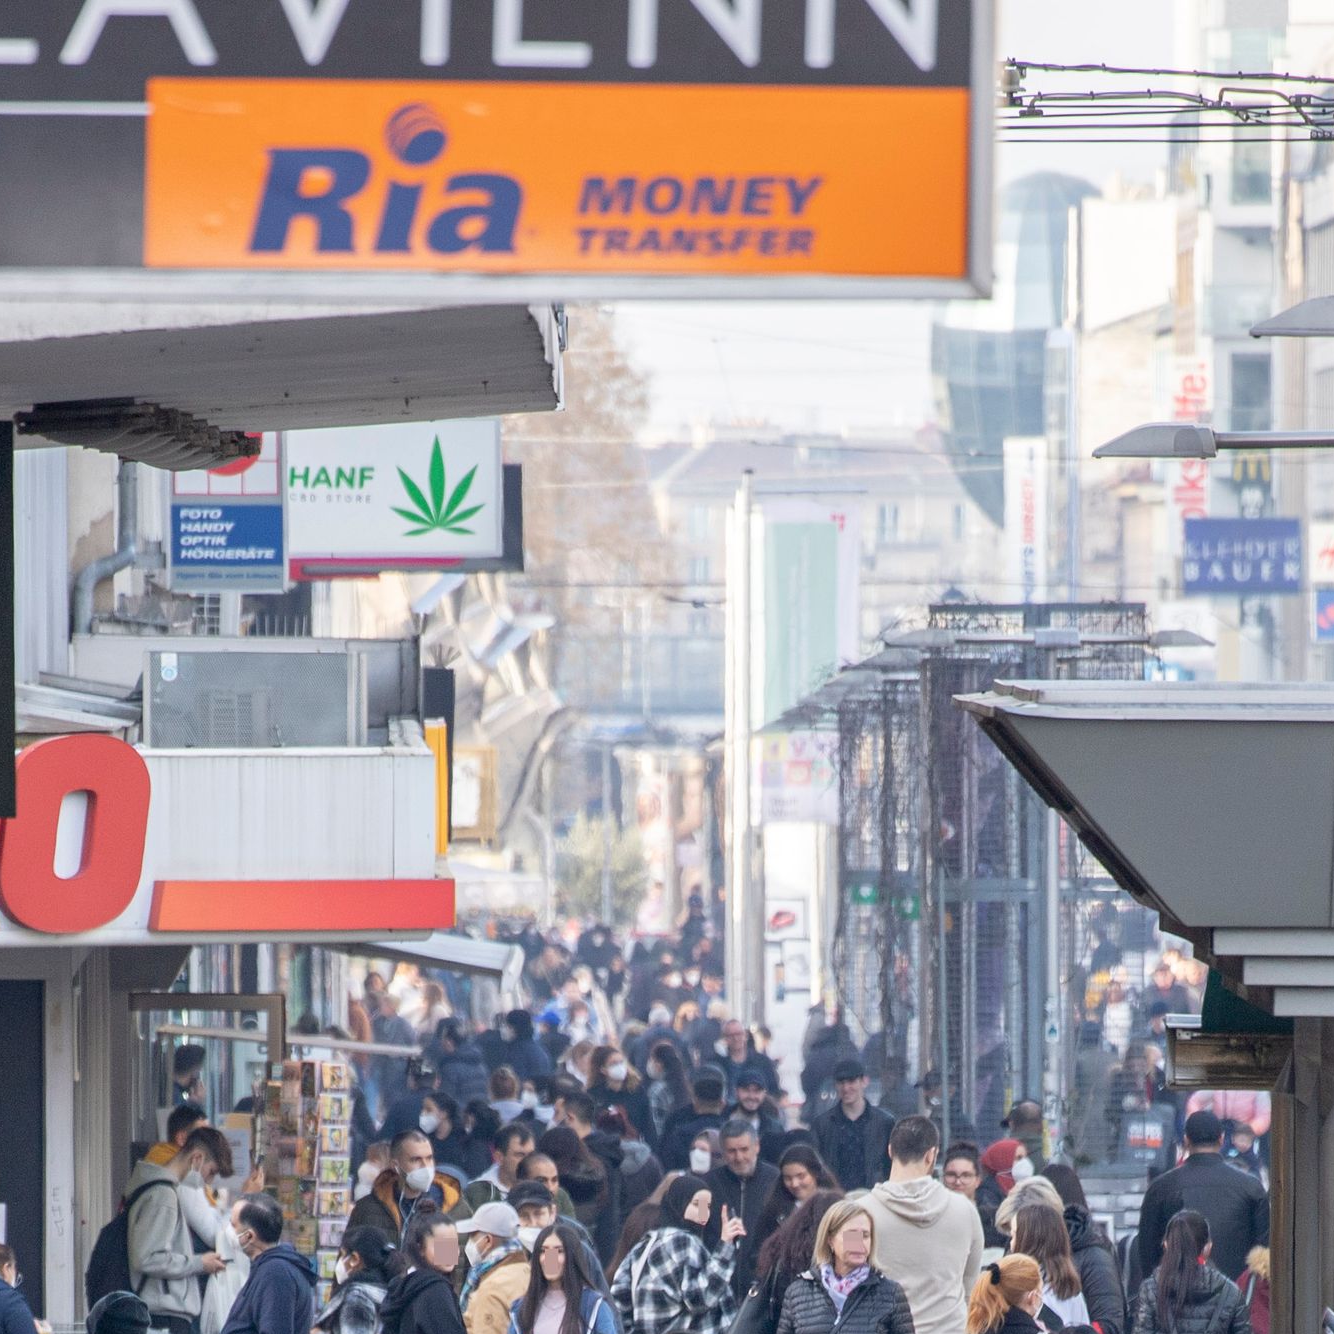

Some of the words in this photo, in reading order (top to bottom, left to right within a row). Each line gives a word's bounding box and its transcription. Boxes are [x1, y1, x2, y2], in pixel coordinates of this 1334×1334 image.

[248, 102, 524, 253] Ria
[577, 175, 822, 216] MONEY
[578, 229, 817, 256] TRANSFER
[290, 466, 374, 489] HANF
[326, 494, 371, 504] STORE
[180, 508, 222, 519] FOTO
[180, 521, 234, 533] HANDY
[180, 535, 227, 546] OPTIK
[180, 547, 275, 560] HÖRGERÄTE
